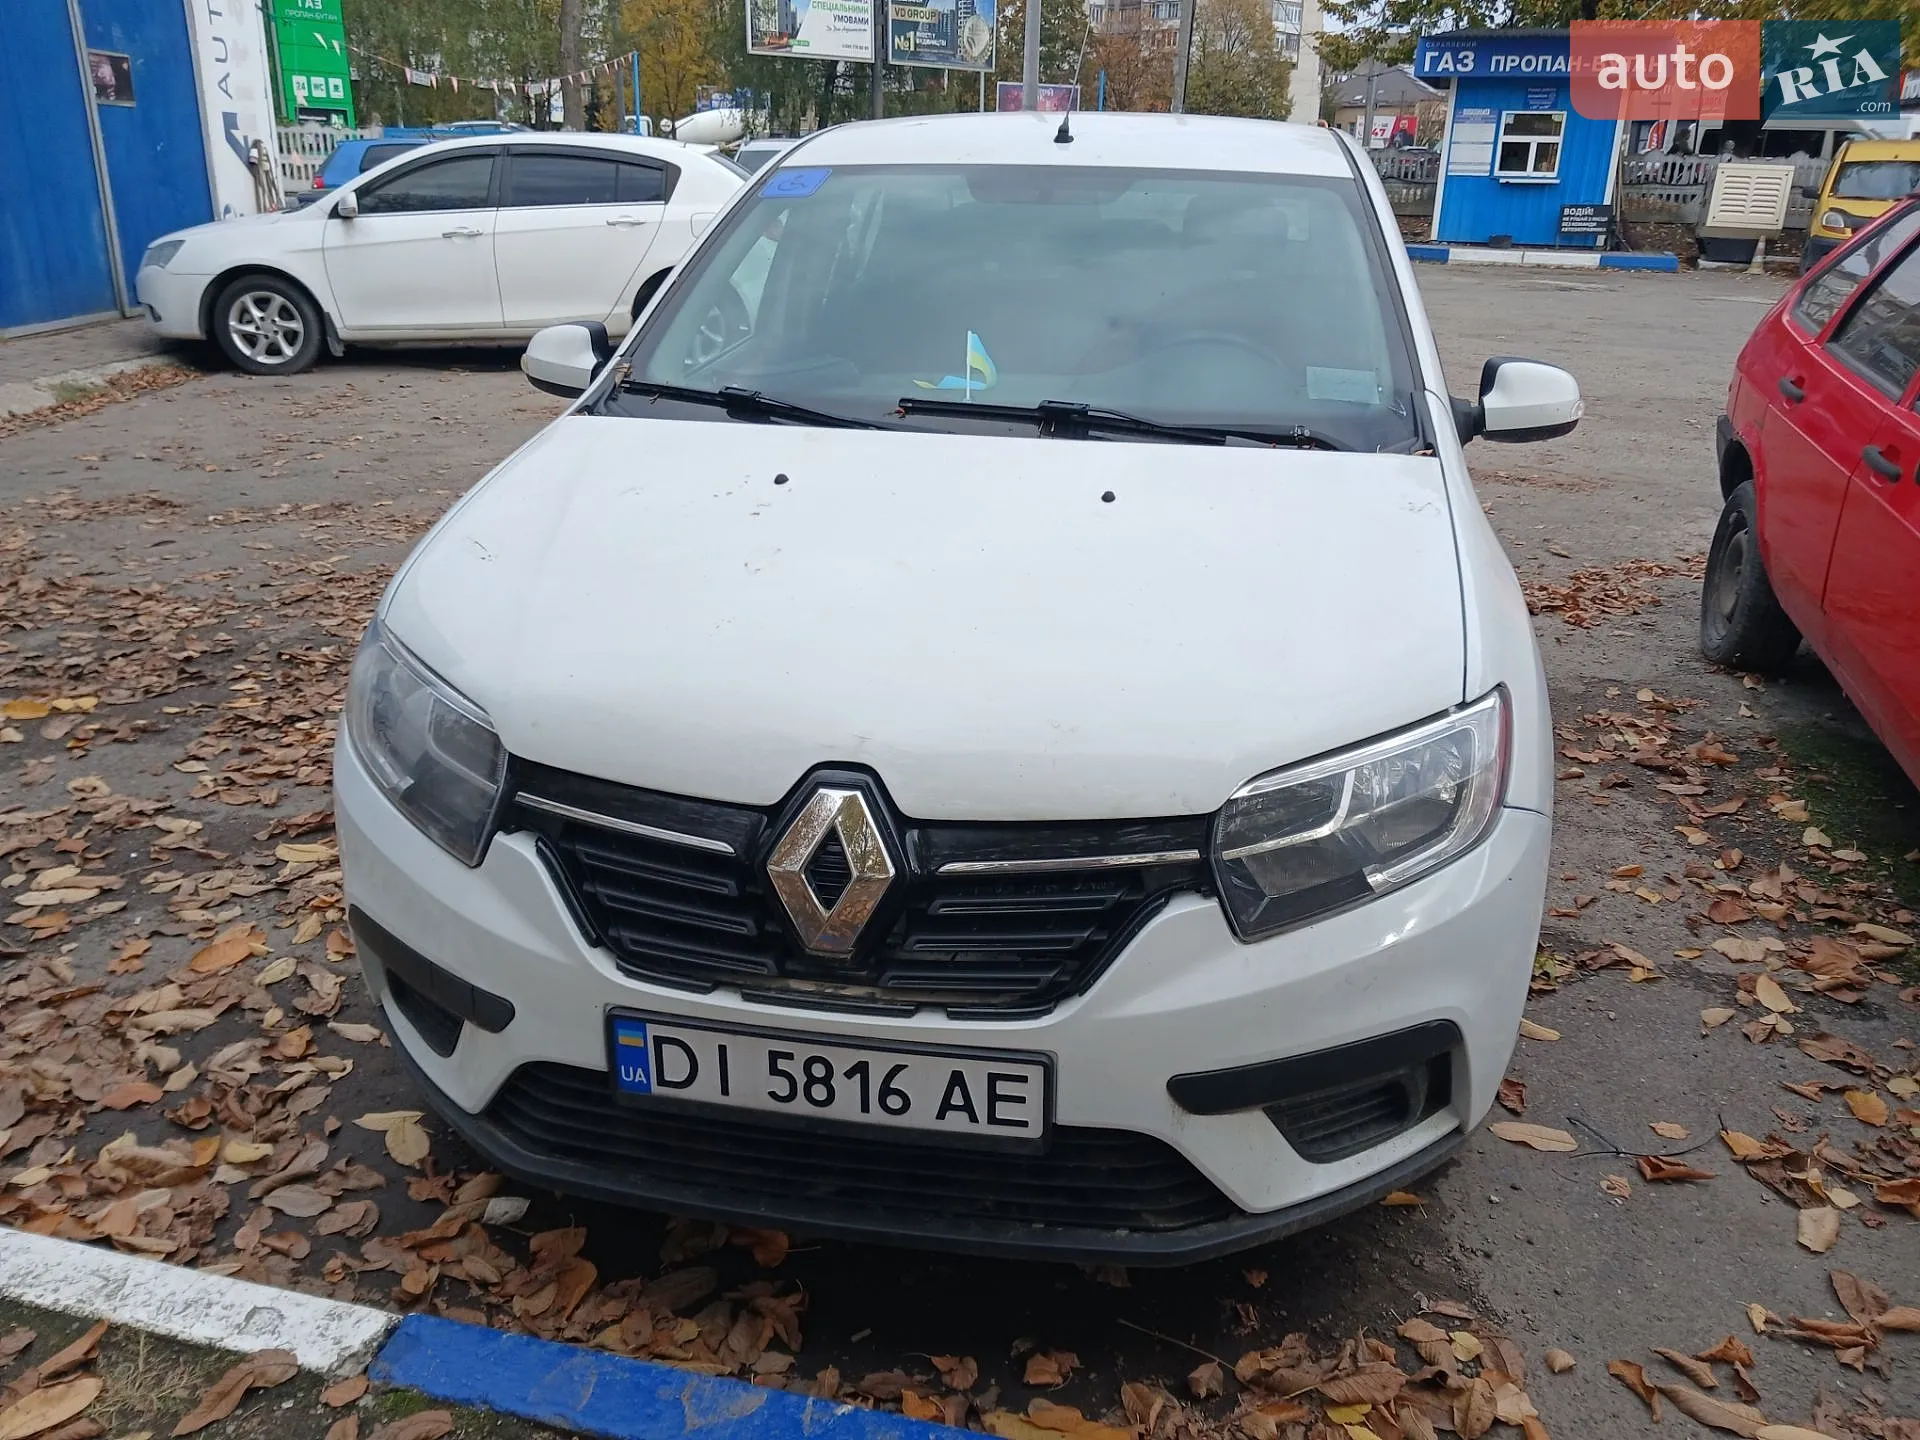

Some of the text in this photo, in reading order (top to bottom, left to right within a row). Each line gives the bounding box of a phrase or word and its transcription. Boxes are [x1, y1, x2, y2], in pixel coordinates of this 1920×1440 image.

[832, 14, 869, 25] УМОВАМИ
[907, 9, 937, 20] GROUP
[1423, 51, 1475, 73] ГАЗ
[313, 83, 324, 92] WC
[620, 1064, 648, 1085] UA
[652, 1034, 1030, 1128] DI 5816 AE
